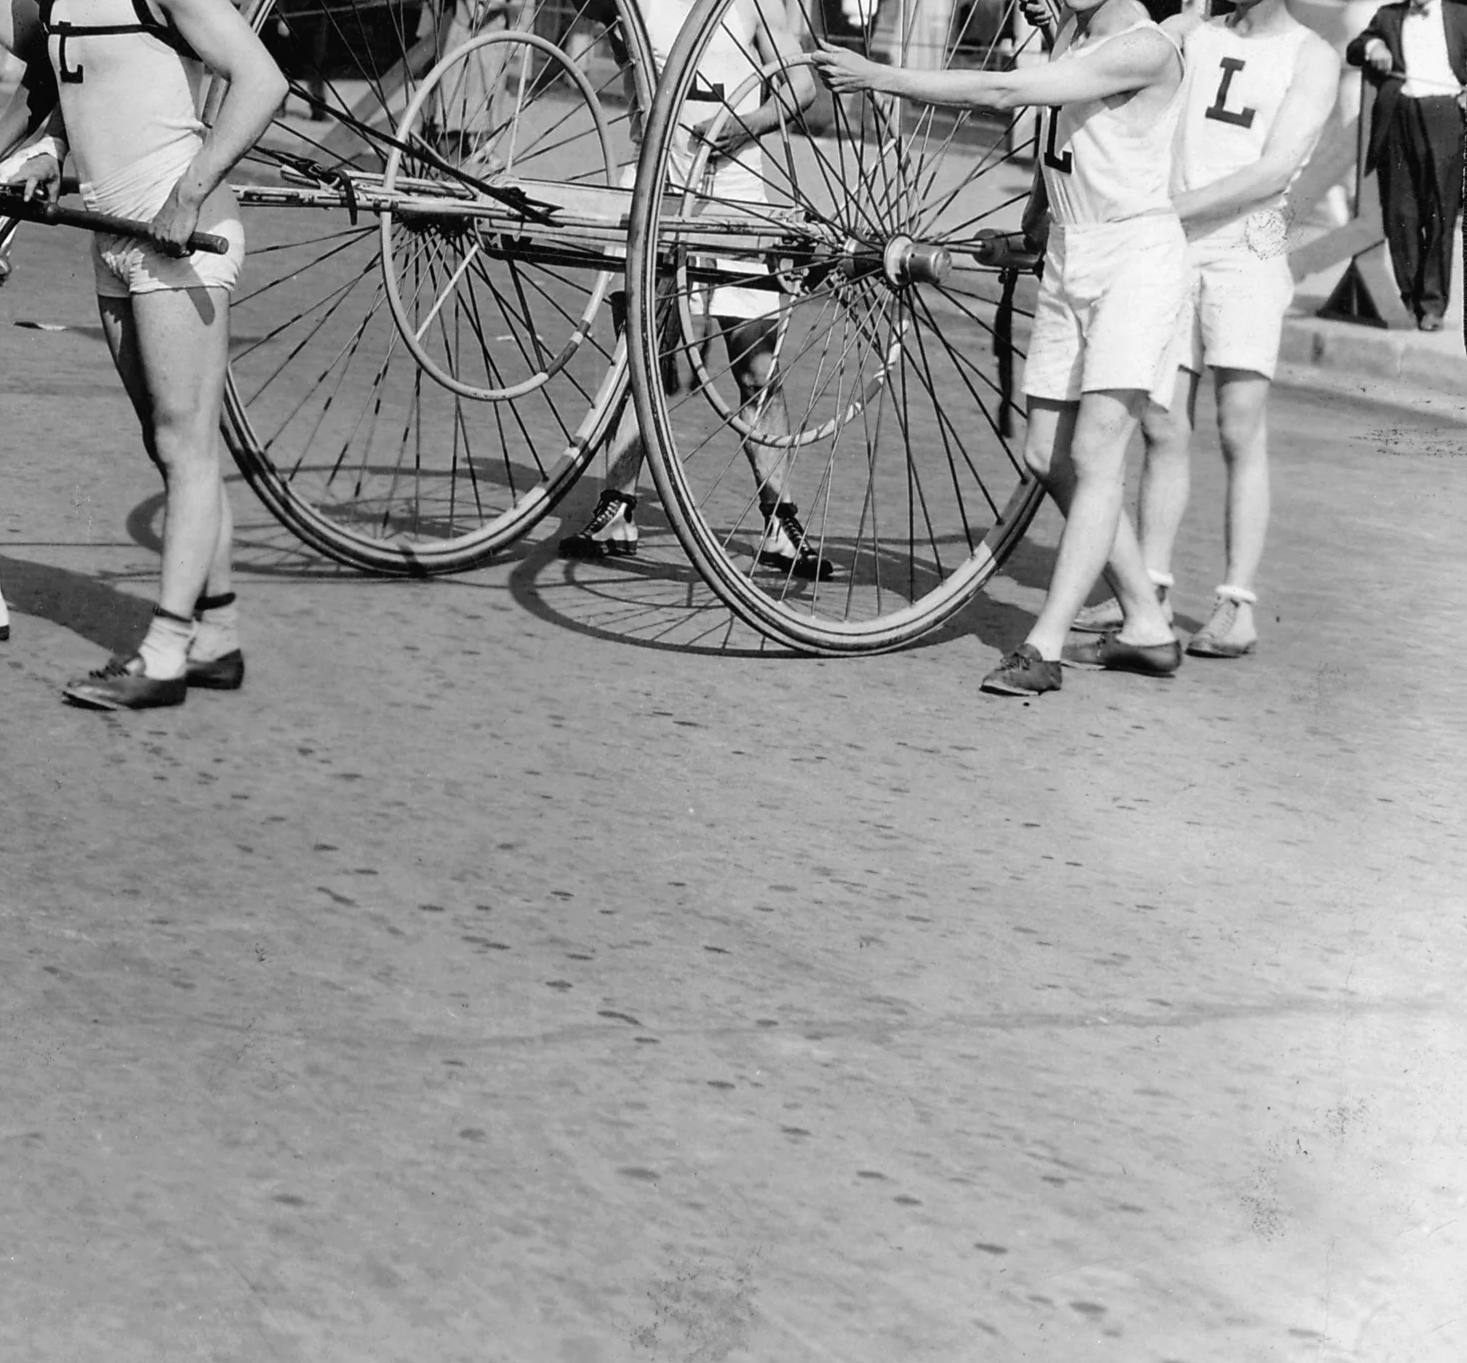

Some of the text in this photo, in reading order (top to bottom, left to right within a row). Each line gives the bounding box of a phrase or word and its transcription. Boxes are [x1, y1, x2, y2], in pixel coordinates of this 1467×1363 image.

[58, 21, 84, 84] L
[1205, 57, 1256, 129] L
[1044, 104, 1073, 175] L
